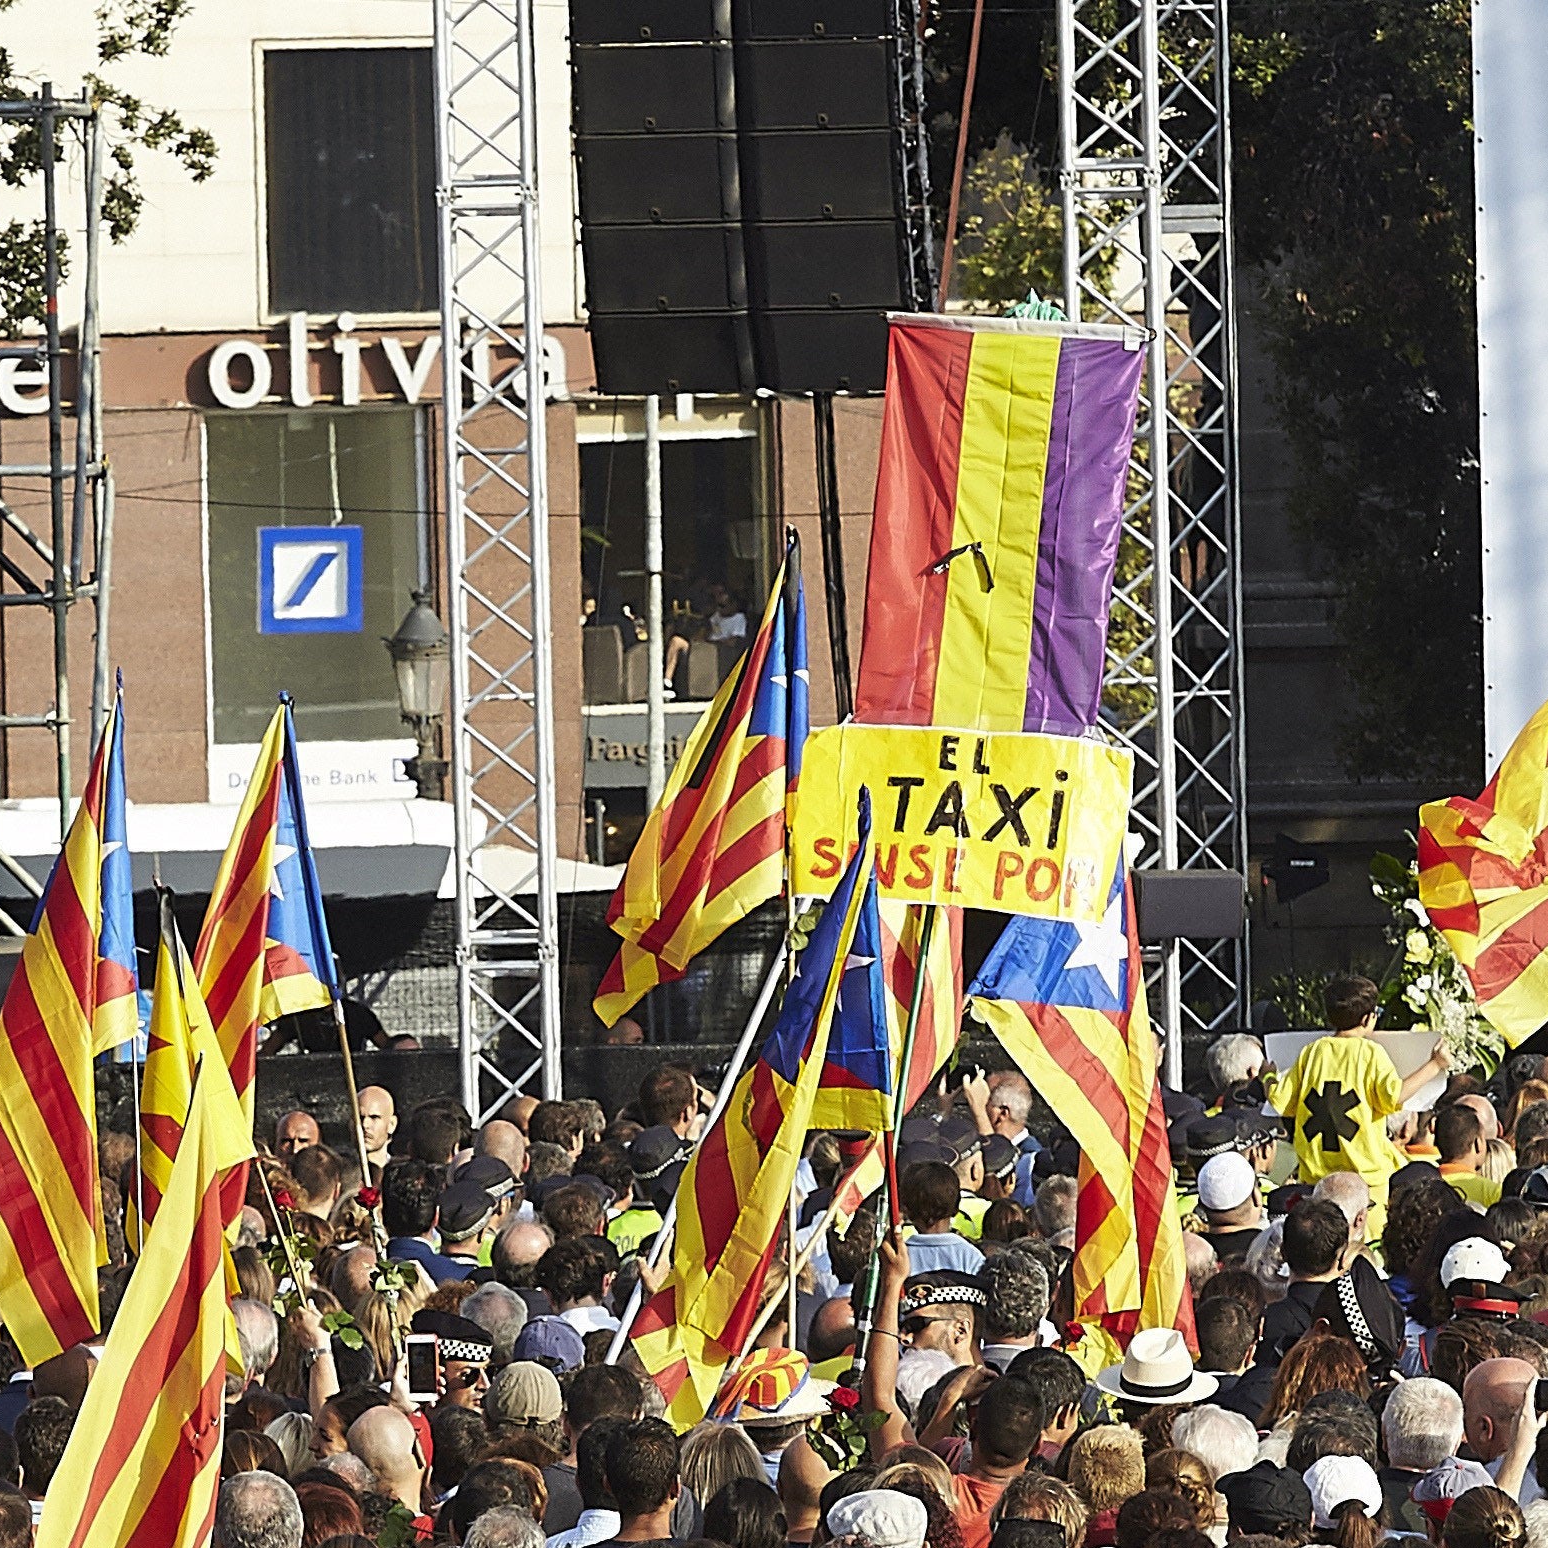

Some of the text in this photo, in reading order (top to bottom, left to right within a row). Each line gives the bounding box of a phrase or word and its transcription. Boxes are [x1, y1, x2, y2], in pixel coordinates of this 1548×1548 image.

[938, 735, 991, 775] EL
[330, 769, 379, 786] Bank
[810, 837, 966, 893] SNSE
